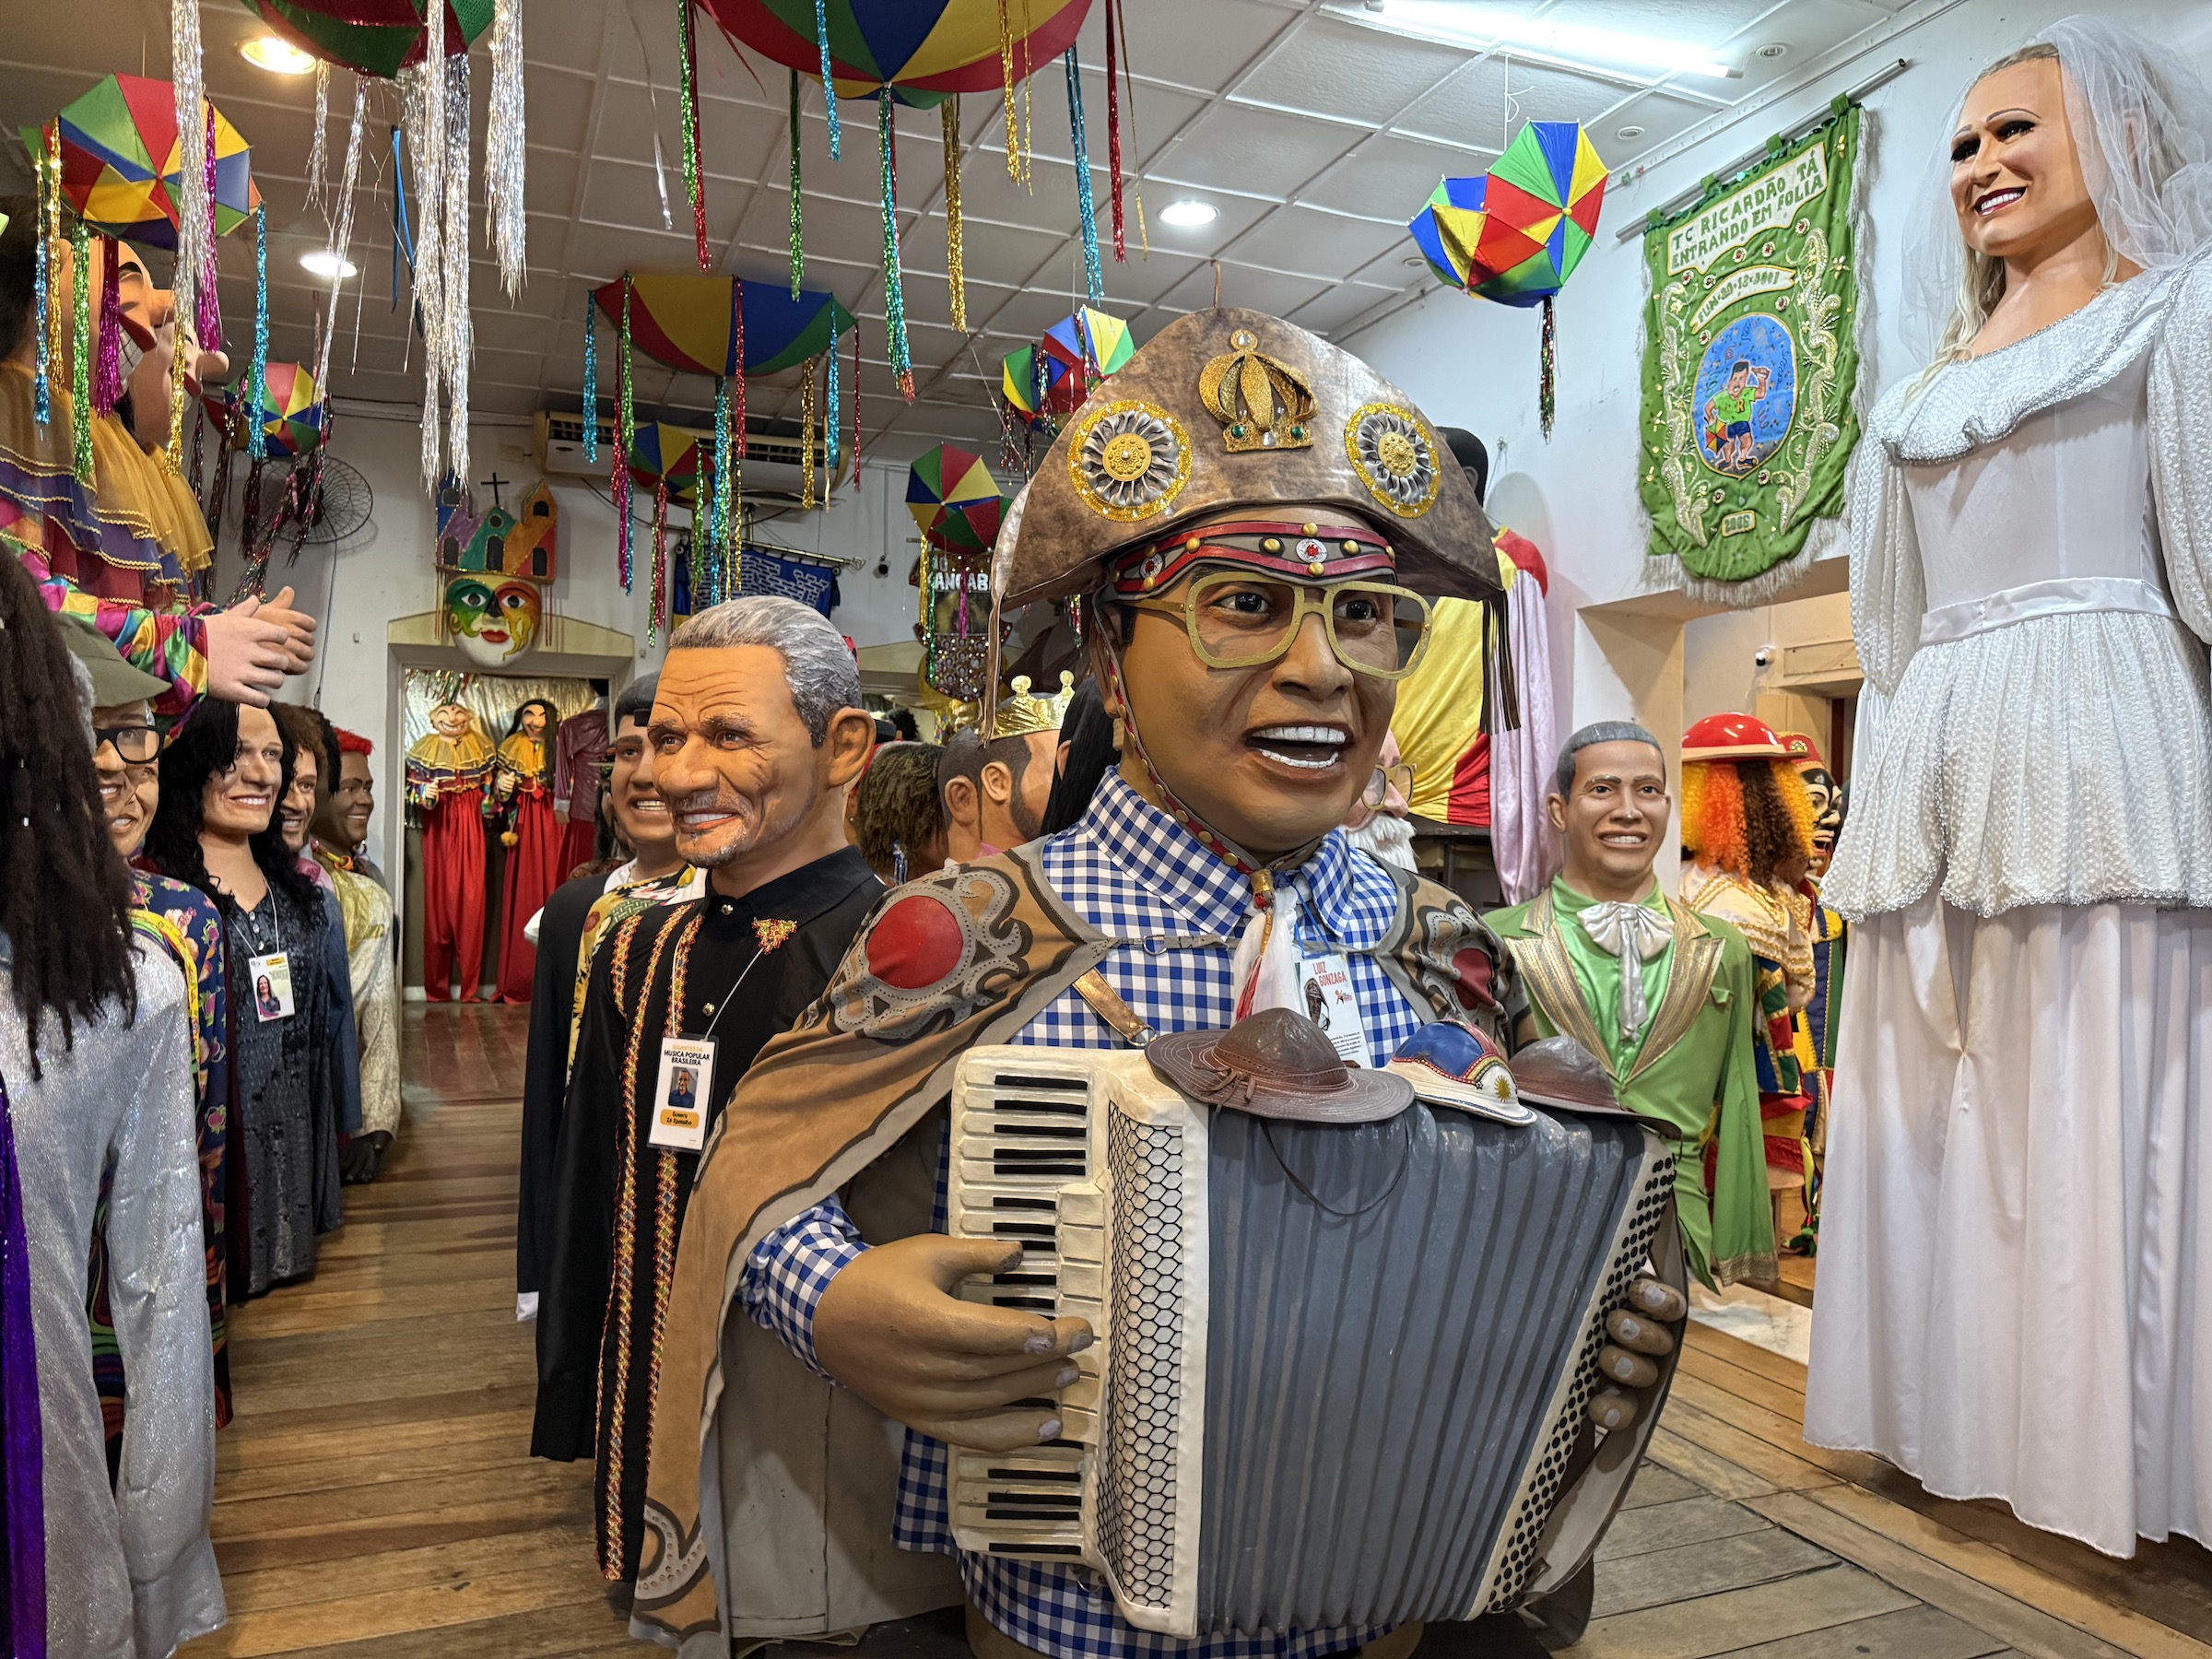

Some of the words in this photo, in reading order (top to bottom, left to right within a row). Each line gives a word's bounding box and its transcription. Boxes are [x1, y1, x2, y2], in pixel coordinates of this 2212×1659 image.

[1672, 226, 1693, 250] TC
[1700, 176, 1786, 236] RICARDÃO
[1796, 149, 1818, 182] TÁ
[1671, 218, 1748, 269] ENTRANDO
[1751, 204, 1772, 228] EM
[1777, 174, 1824, 212] FOLIA
[1736, 399, 1745, 413] R
[1312, 960, 1327, 975] LUIZ
[1318, 971, 1347, 987] GONZAGA
[671, 1057, 701, 1066] BRASILEIRA
[685, 1052, 711, 1060] POPULAR
